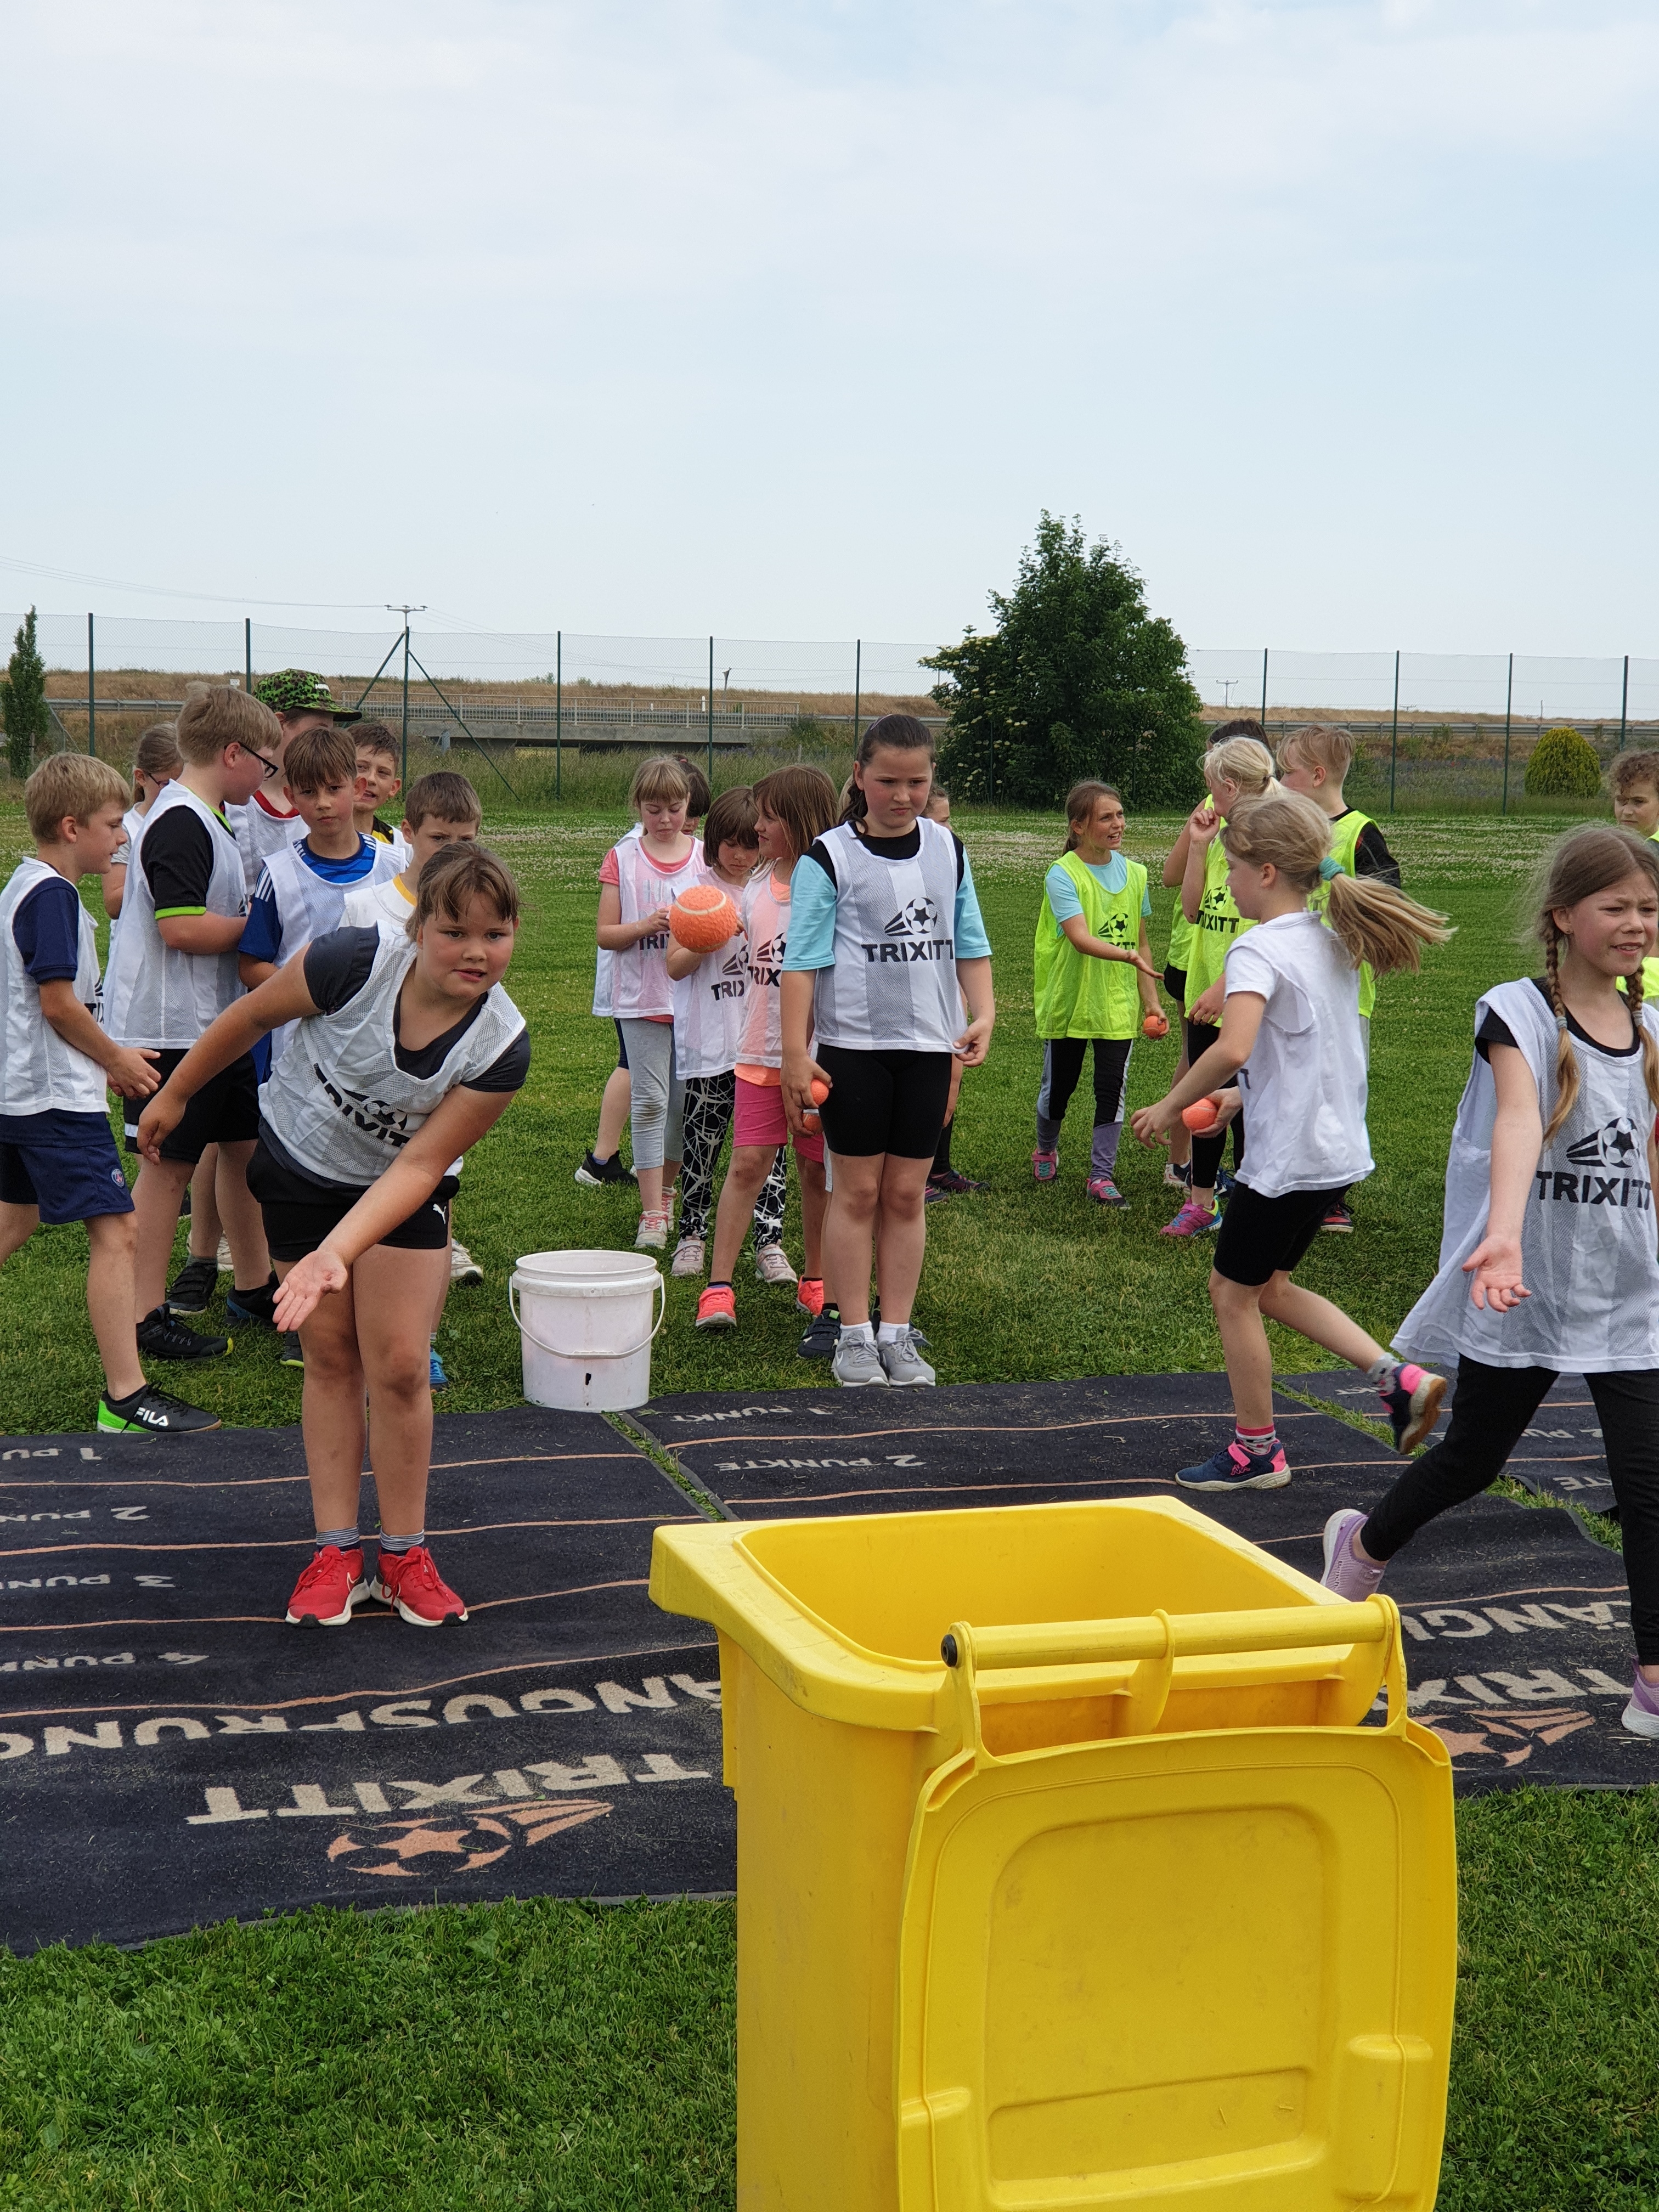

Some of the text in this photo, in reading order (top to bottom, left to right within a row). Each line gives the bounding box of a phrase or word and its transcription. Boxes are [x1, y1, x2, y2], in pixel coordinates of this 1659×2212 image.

[639, 933, 670, 950] TRI
[861, 939, 954, 962] TRIXITT
[134, 1407, 168, 1426] FILA
[670, 1407, 793, 1422] PUNKT
[80, 1447, 103, 1460] 1
[714, 1454, 926, 1471] 2 PUNKTE
[110, 1506, 150, 1521] 2
[0, 1573, 176, 1590] 3 PUN
[158, 1652, 210, 1666] 4
[185, 1754, 712, 1825] TRIXITT
